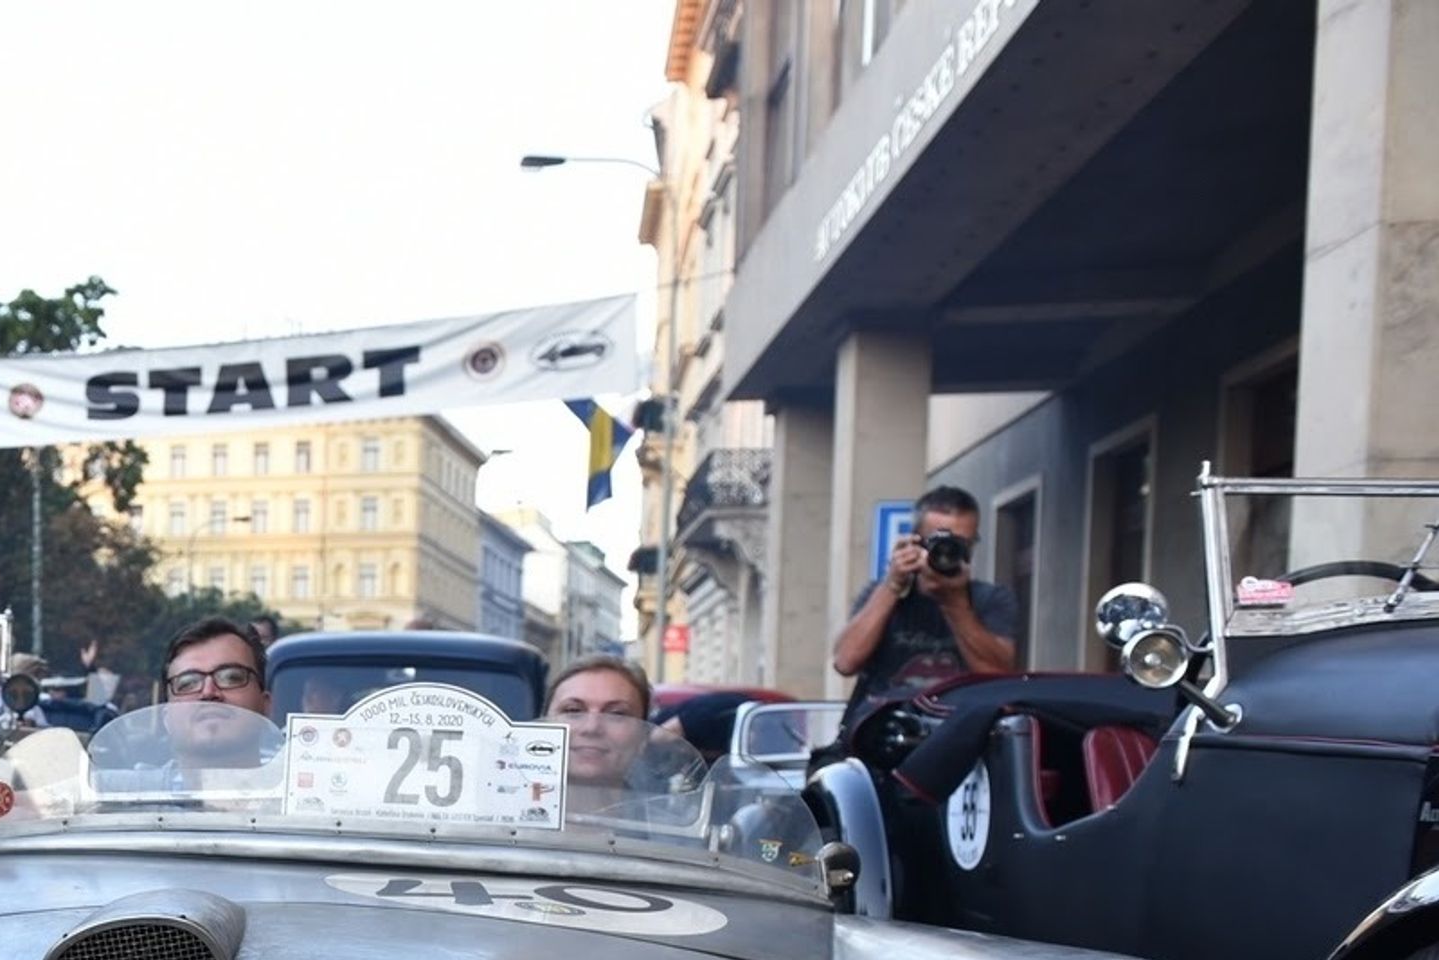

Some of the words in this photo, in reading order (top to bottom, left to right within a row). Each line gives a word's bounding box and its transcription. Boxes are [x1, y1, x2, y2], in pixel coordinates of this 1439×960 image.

[86, 346, 421, 420] START
[360, 701, 387, 722] 1000
[388, 695, 407, 710] MIL
[410, 691, 495, 728] ČESKOSLOVENSKÝCH
[438, 714, 464, 727] 2020
[383, 727, 464, 807] 25
